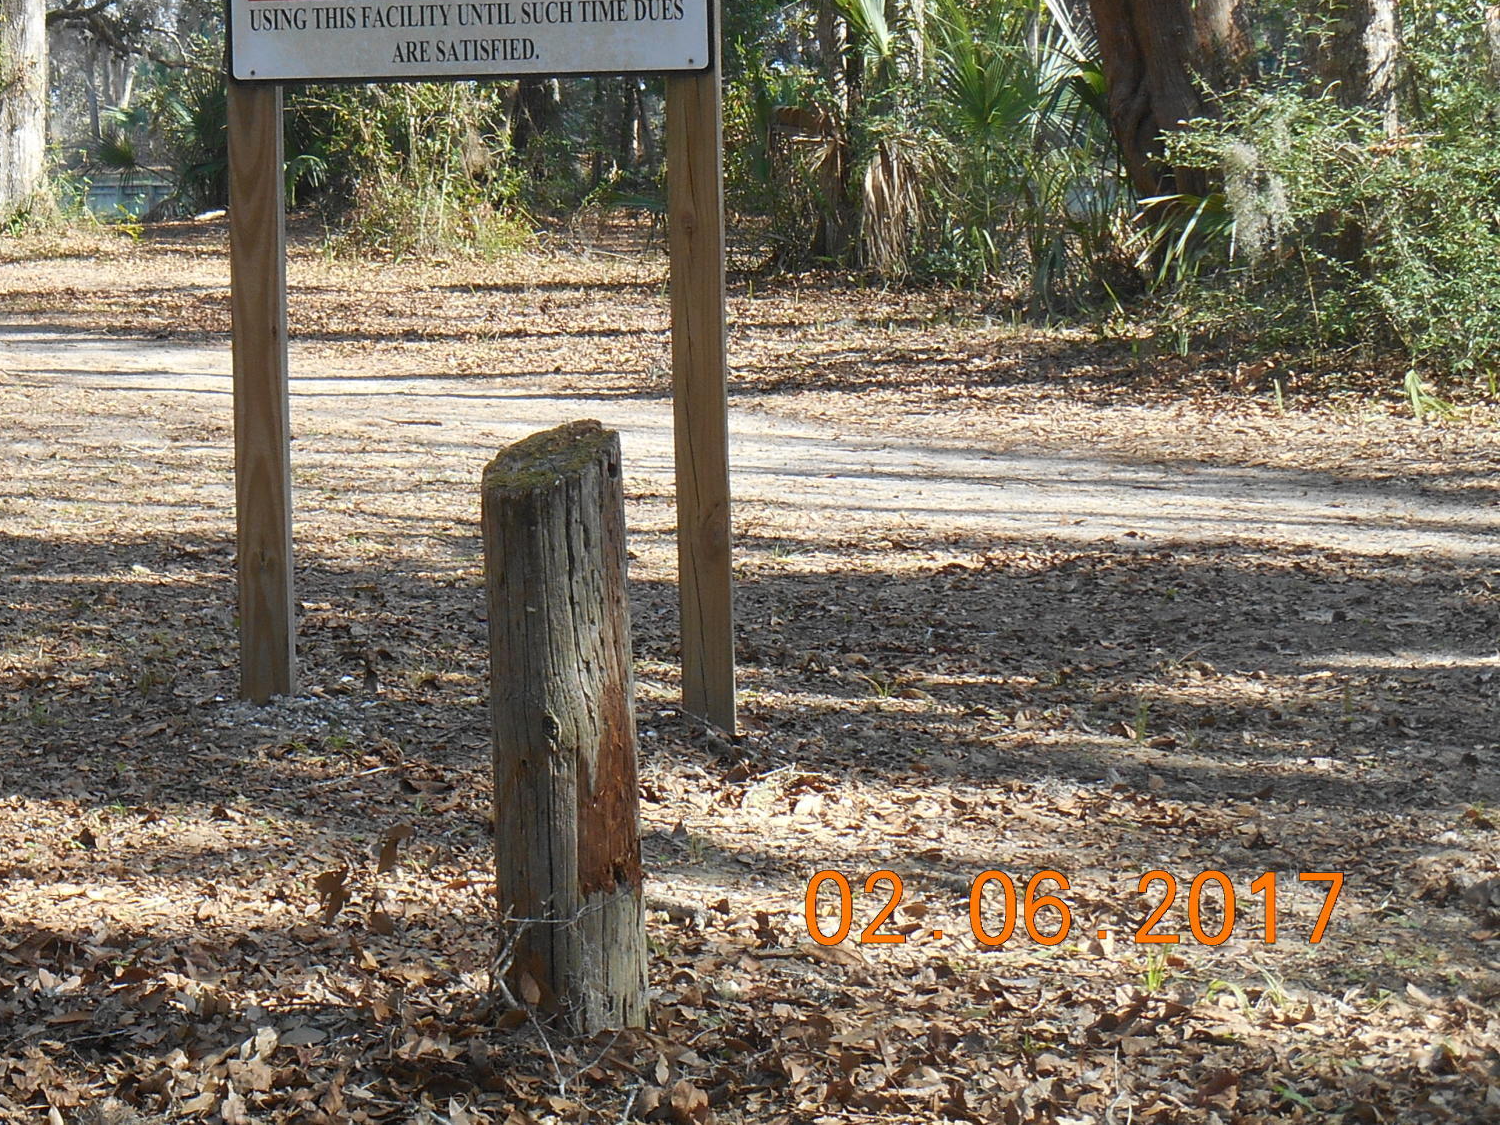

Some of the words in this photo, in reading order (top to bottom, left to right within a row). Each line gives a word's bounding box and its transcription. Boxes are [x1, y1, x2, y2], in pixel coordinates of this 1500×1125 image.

[249, 8, 307, 32] USING
[312, 6, 356, 30] THIS
[361, 4, 451, 28] FACILITY
[457, 2, 516, 26] UNTIL
[521, 1, 573, 25] SUCH
[578, 0, 629, 23] TIME
[392, 40, 431, 63] ARE
[436, 38, 540, 62] SATISFIED.
